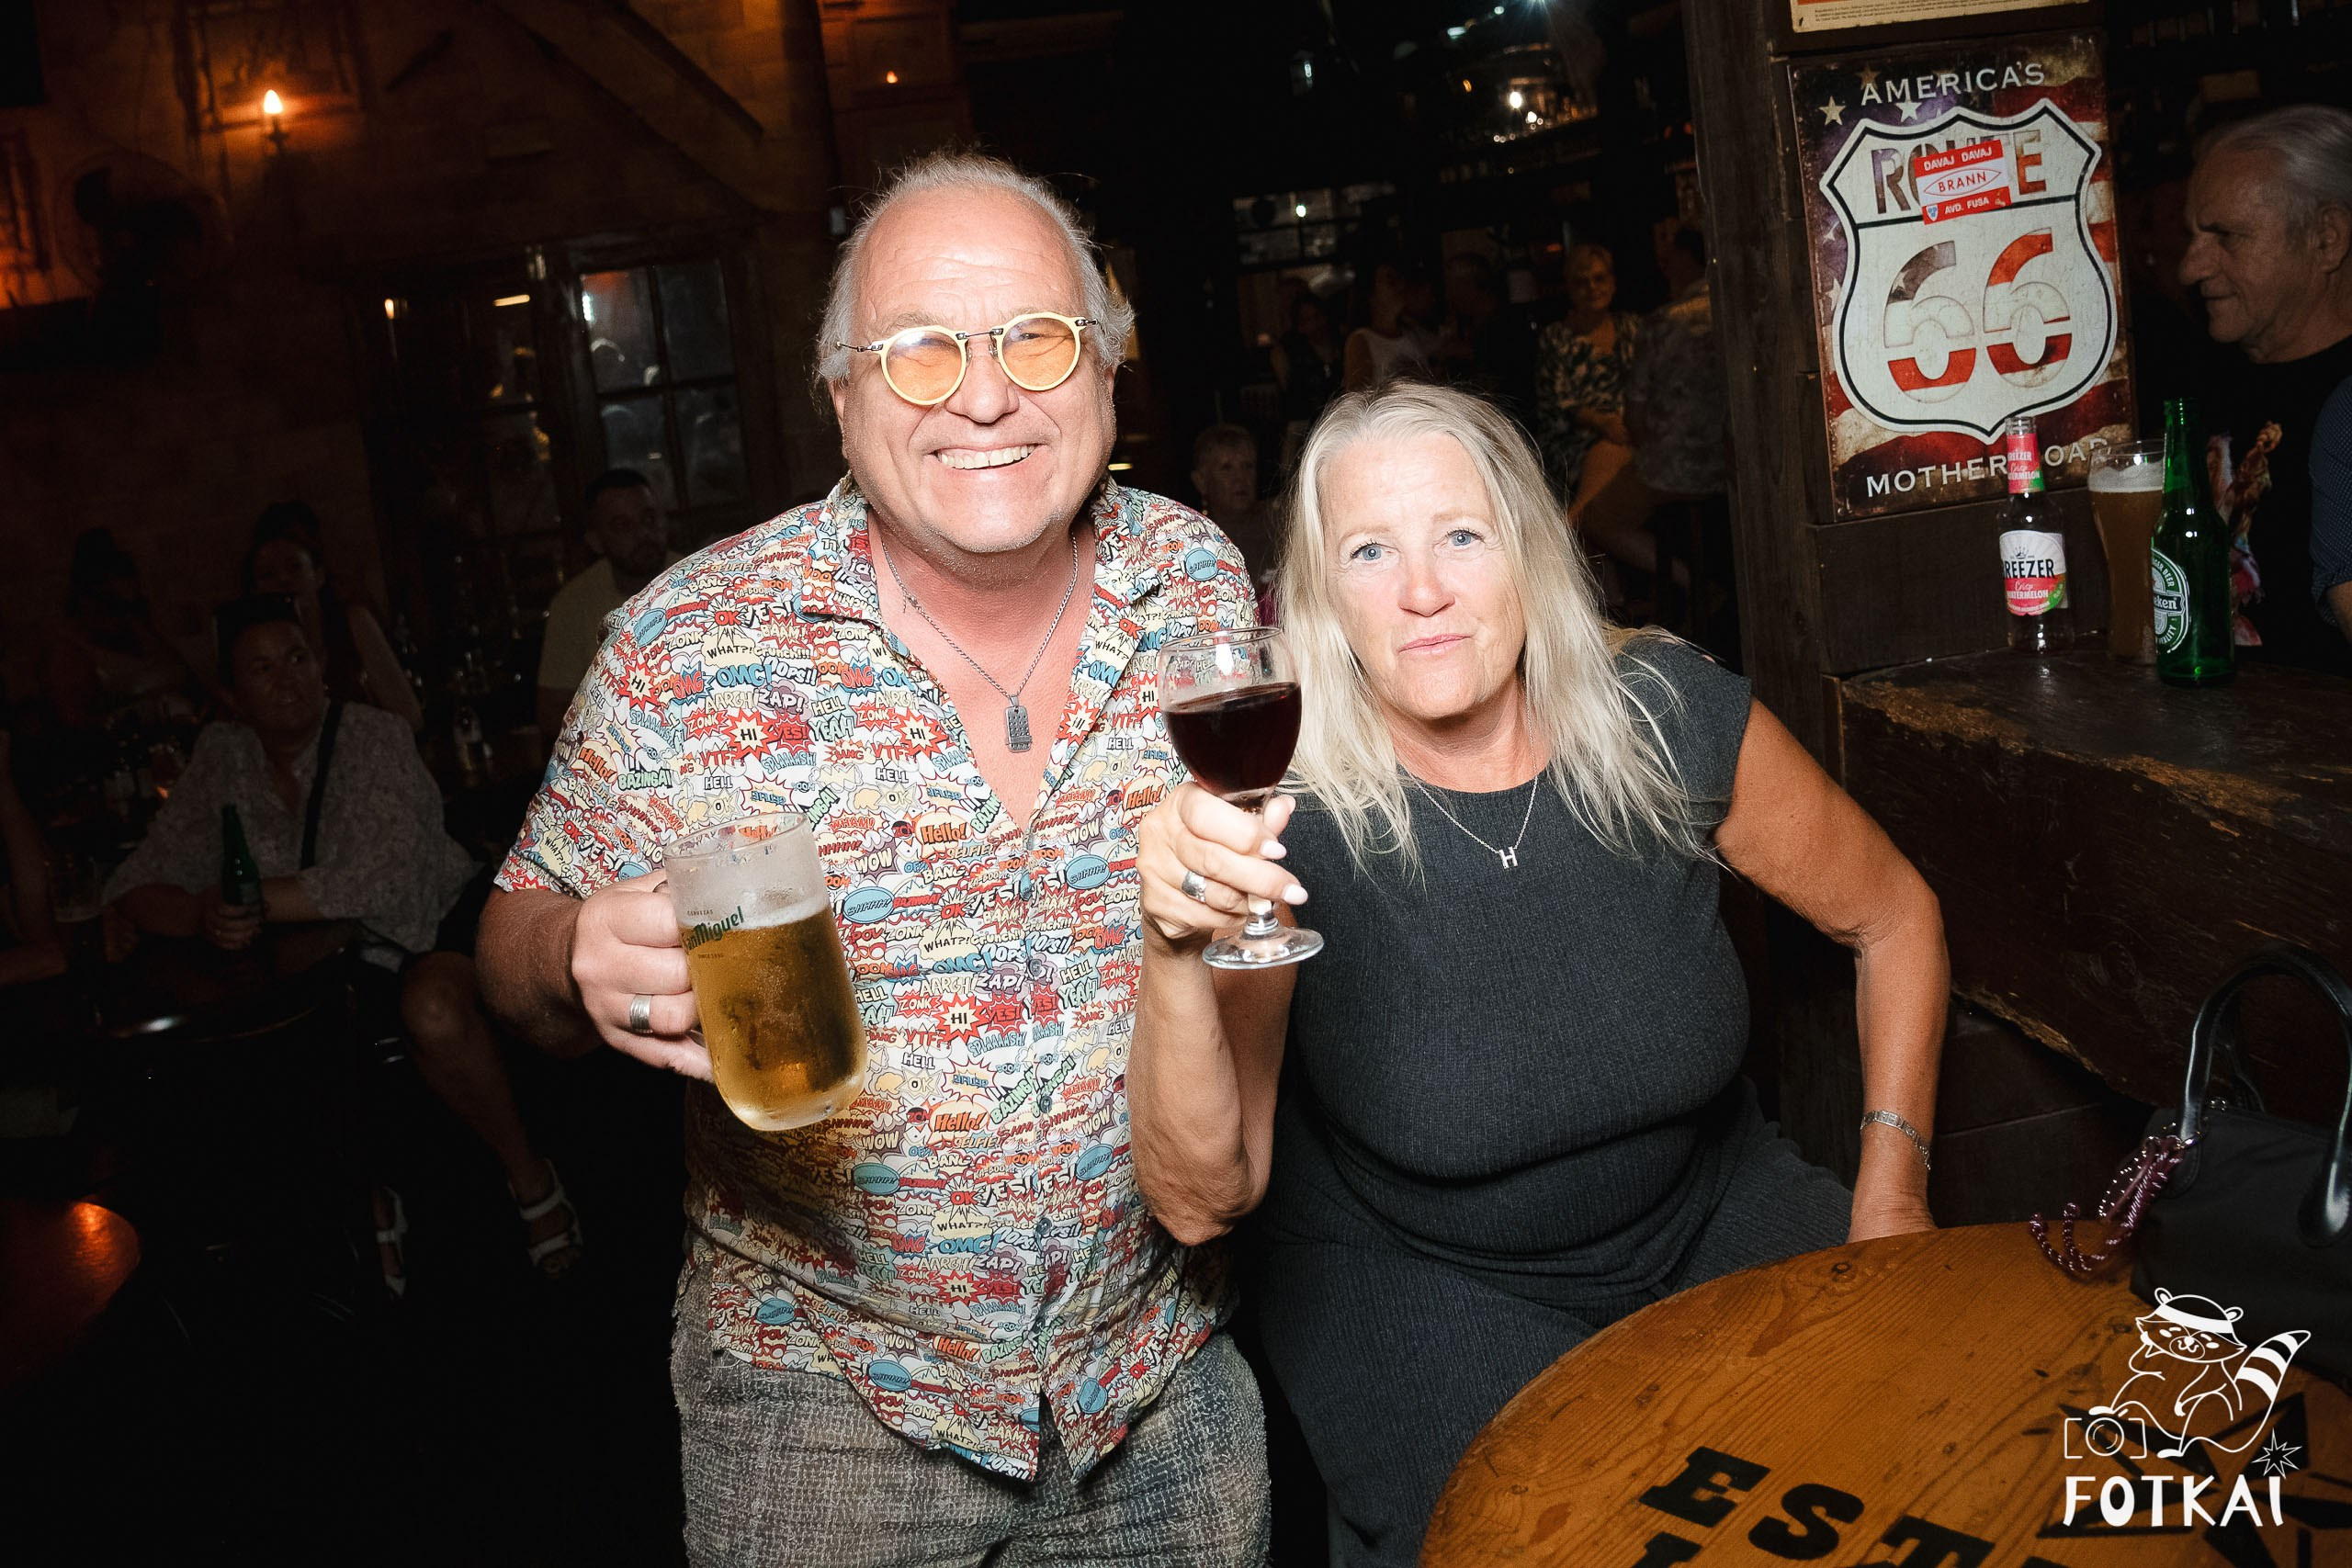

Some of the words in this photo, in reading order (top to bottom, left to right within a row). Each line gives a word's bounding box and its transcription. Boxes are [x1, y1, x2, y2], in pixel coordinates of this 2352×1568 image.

[1861, 62, 2045, 106] AMERICA'S
[1924, 156, 1955, 171] DAVAJ
[1962, 146, 1993, 163] DAVAJ
[1871, 130, 2047, 216] ROE
[1938, 171, 1987, 193] BRANN
[1944, 204, 1963, 215] AVD.
[1967, 196, 1991, 210] FUSA
[1883, 227, 2072, 403] 66
[1866, 455, 2008, 498] MOTHER
[2044, 438, 2108, 467] OA
[2002, 558, 2055, 579] REEZER
[2154, 595, 2177, 610] eken
[715, 612, 741, 625] OK
[1119, 618, 1143, 637] OK
[668, 635, 704, 650] ZONK
[707, 646, 753, 659] WHAT?!
[631, 677, 645, 692] HI
[1143, 691, 1154, 702] HI
[812, 697, 845, 716] HELL
[858, 709, 888, 721] ZONK
[689, 715, 718, 730] ZONK
[809, 716, 854, 741] YEAH
[741, 729, 757, 740] HI
[910, 728, 926, 739] HI
[1107, 738, 1134, 750] HELL
[581, 746, 615, 781] Hello!
[705, 776, 732, 789] HELL
[876, 769, 909, 783] HELL
[1127, 784, 1163, 808] Hello!
[563, 821, 580, 843] OK
[831, 818, 874, 829] WHAM!
[1067, 819, 1101, 842] WOW
[921, 823, 967, 844] Hello!
[644, 839, 663, 861] WO
[1498, 846, 1519, 870] H
[855, 848, 892, 873] WOW
[941, 903, 967, 919] OK
[694, 906, 745, 944] Miguel
[924, 936, 970, 953] WHAT?!
[1061, 962, 1091, 984] HELL
[1058, 979, 1098, 1009] YEAH
[900, 998, 932, 1010] ZONK
[952, 1012, 967, 1023] HI
[989, 1008, 1019, 1021] YES!
[902, 1053, 935, 1069] HELL
[934, 1111, 984, 1132] Hello!
[1082, 1107, 1110, 1135] WOW
[862, 1133, 899, 1149] WOW
[951, 1191, 978, 1205] OK
[938, 1222, 987, 1230] WHAT?!
[951, 1282, 966, 1292] HI
[937, 1338, 978, 1361] Hello!
[1130, 1359, 1150, 1379] OK
[937, 1430, 977, 1450] WHAT?!
